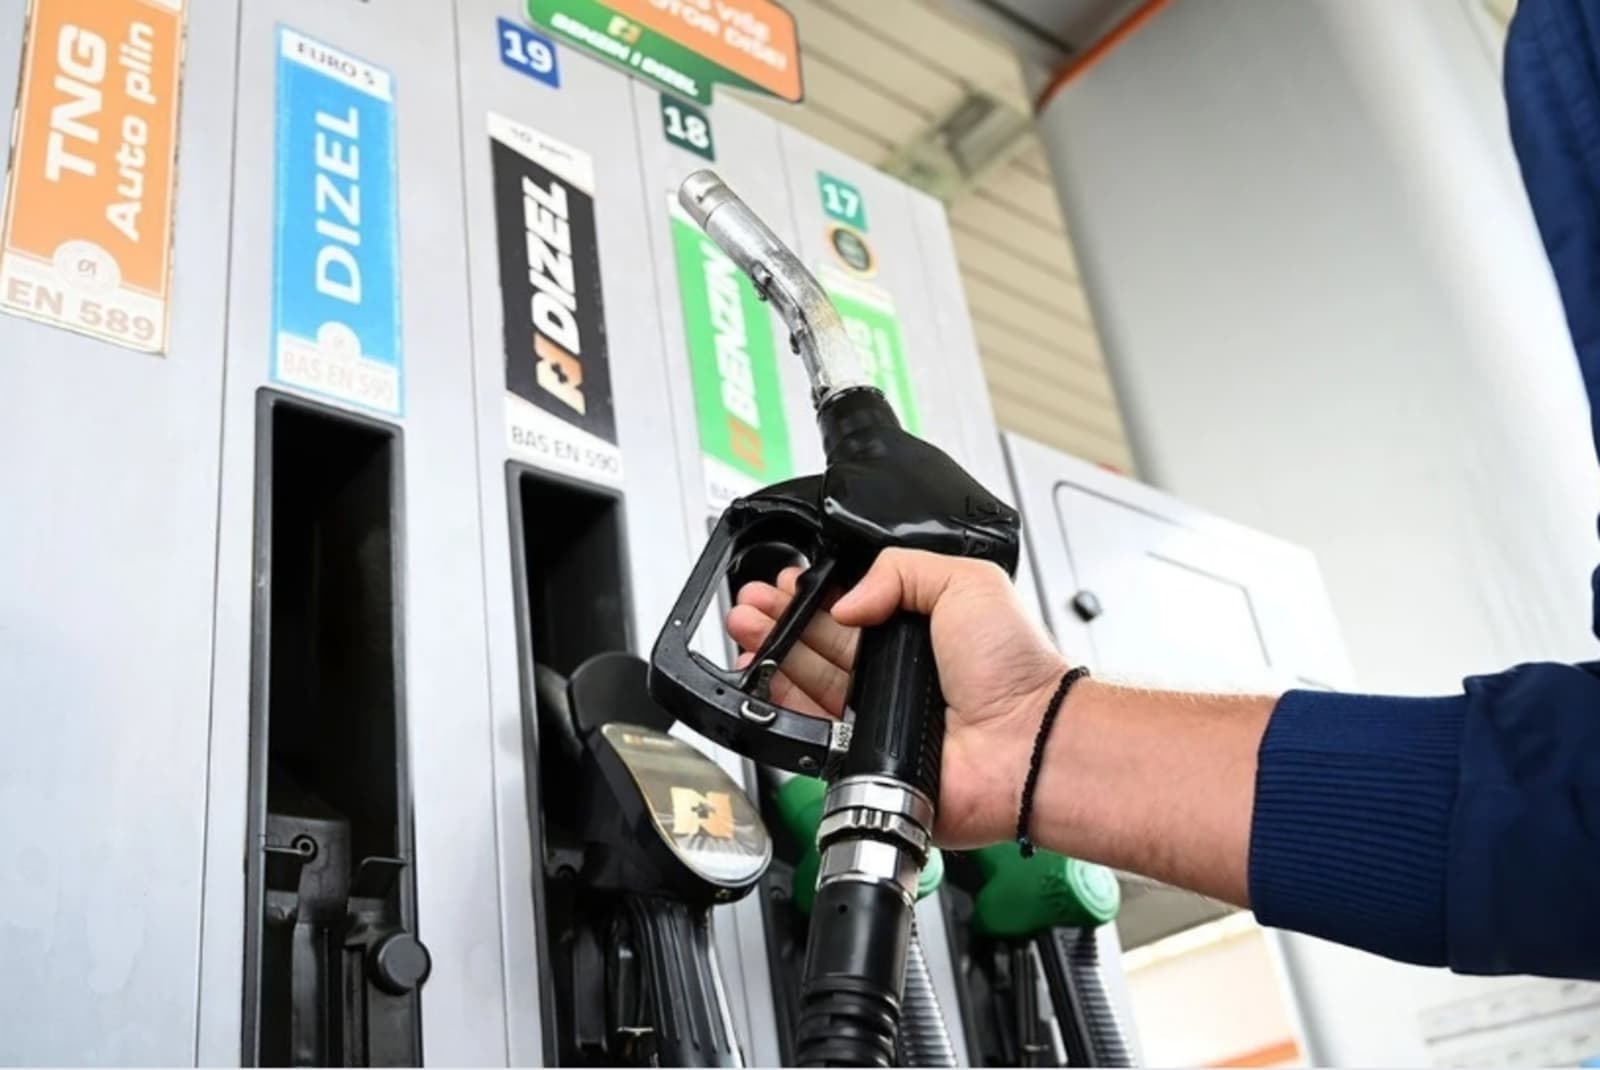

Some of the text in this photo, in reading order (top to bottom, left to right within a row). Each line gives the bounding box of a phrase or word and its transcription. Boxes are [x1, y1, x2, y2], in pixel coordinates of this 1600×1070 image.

[297, 42, 357, 78] EURO
[502, 29, 554, 74] 19
[45, 24, 107, 182] TNG
[105, 21, 157, 243] Auto plin
[663, 106, 710, 149] 18
[315, 104, 362, 304] DIZEL
[822, 183, 859, 218] 17
[521, 174, 581, 355] DIZEL
[6, 276, 156, 343] EN 589
[511, 424, 620, 475] BAS EN 590
